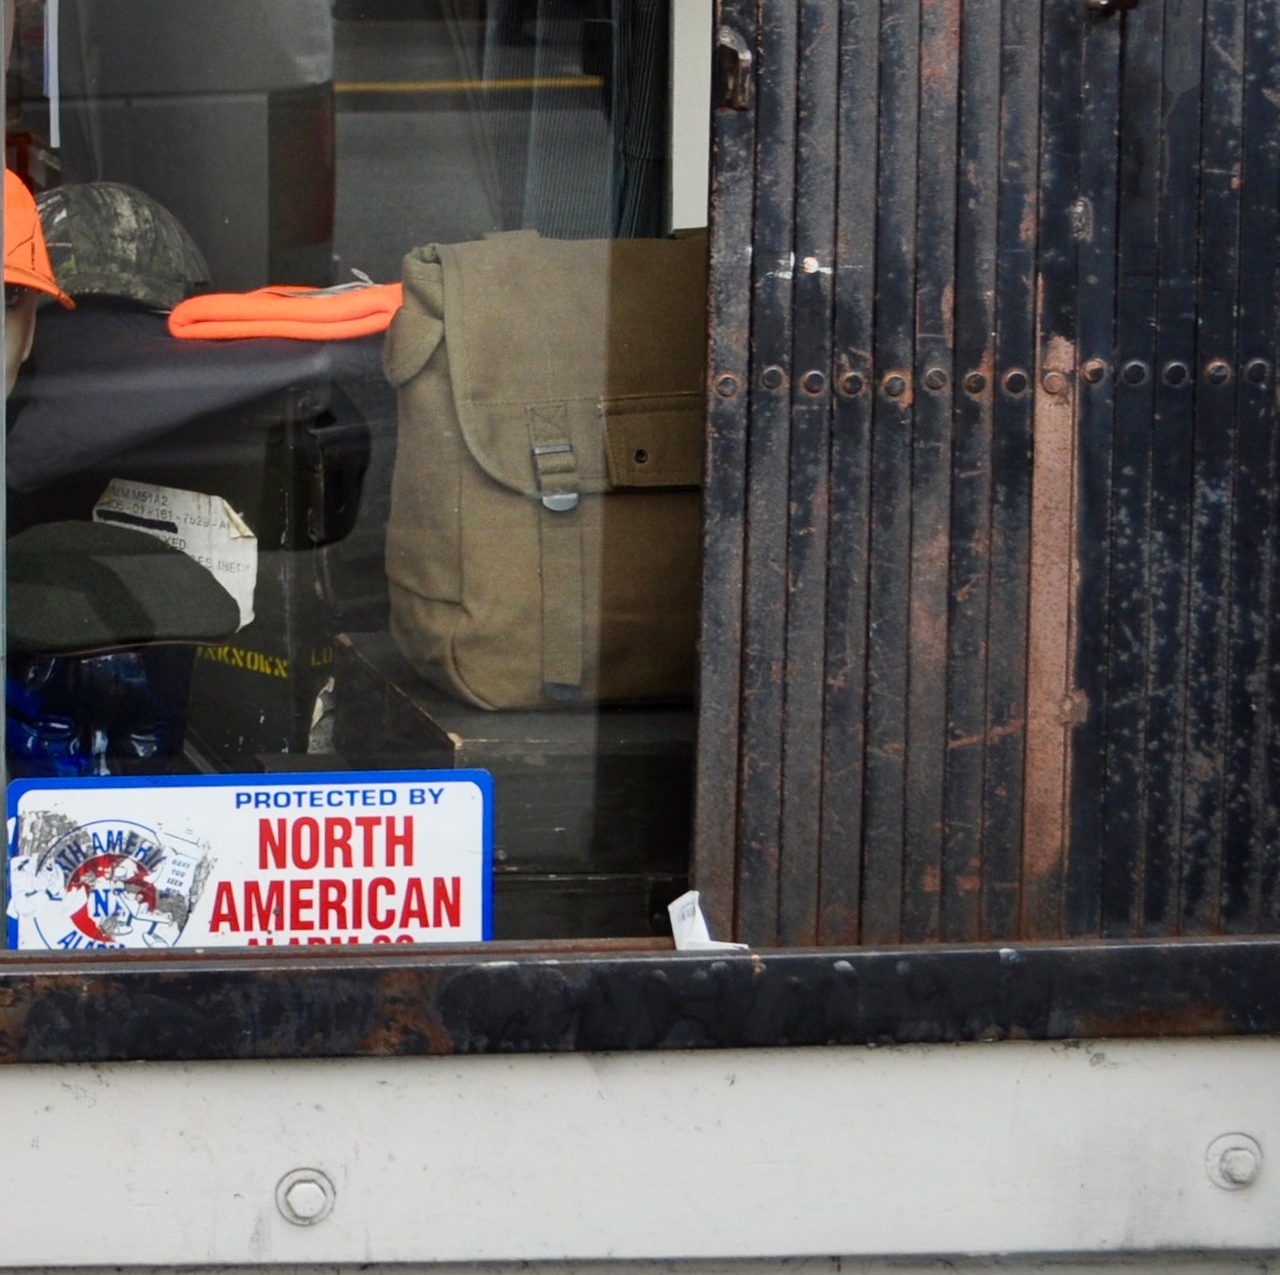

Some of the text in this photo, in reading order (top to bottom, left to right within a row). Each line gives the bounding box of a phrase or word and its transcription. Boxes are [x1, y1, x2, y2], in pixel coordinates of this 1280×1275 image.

[235, 788, 445, 809] PROTECTED BY
[258, 815, 414, 870] NORTH
[209, 876, 462, 933] AMERICAN
